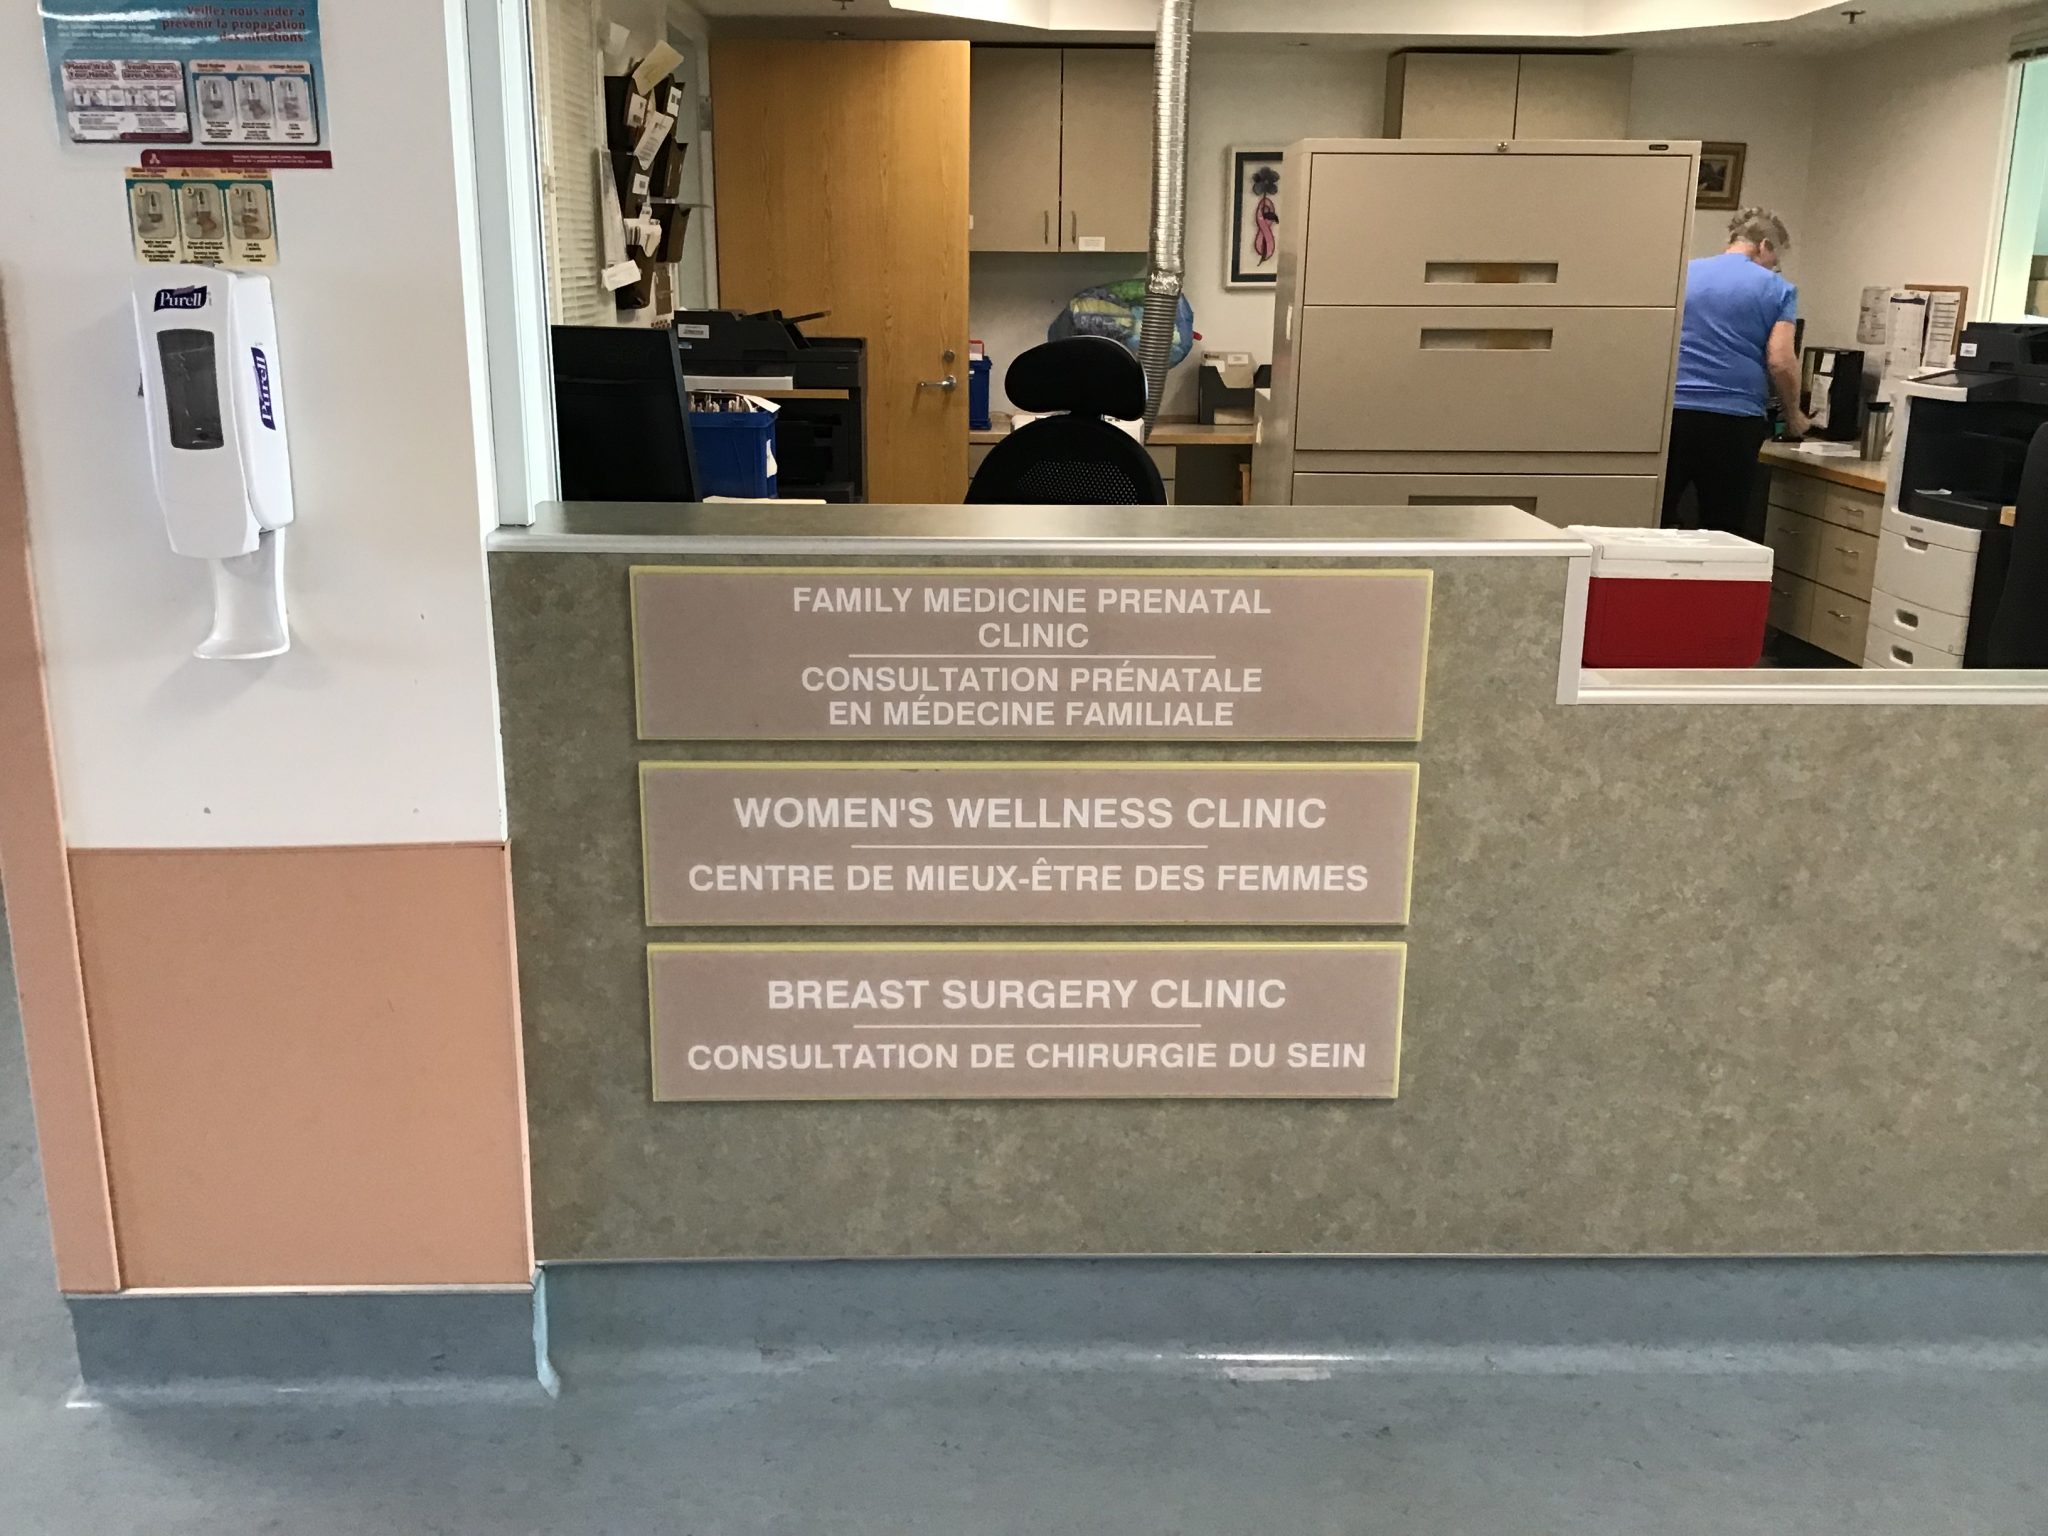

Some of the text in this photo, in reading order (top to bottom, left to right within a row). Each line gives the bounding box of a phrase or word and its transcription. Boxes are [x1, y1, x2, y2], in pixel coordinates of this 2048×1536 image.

[231, 19, 305, 31] propagation
[158, 291, 202, 307] Purell
[256, 355, 272, 420] Purell
[793, 587, 1272, 614] FAMILY MEDICINE PRENATAL
[978, 622, 1089, 648] CLINIC
[801, 660, 1263, 693] CONSULTATION PRÉNATALE
[829, 694, 1234, 727] EN MÉDECINE FAMILIALE
[732, 797, 1327, 829] WOMEN'S WELLNESS CLINIC
[688, 857, 1368, 892] CENTRE DE MIEUX-ÊTRE DES FEMMES
[767, 978, 1287, 1010] BREAST SURGERY CLINIC
[687, 1042, 1366, 1071] CONSULTATION DE CHIRURGIE DU SEIN
